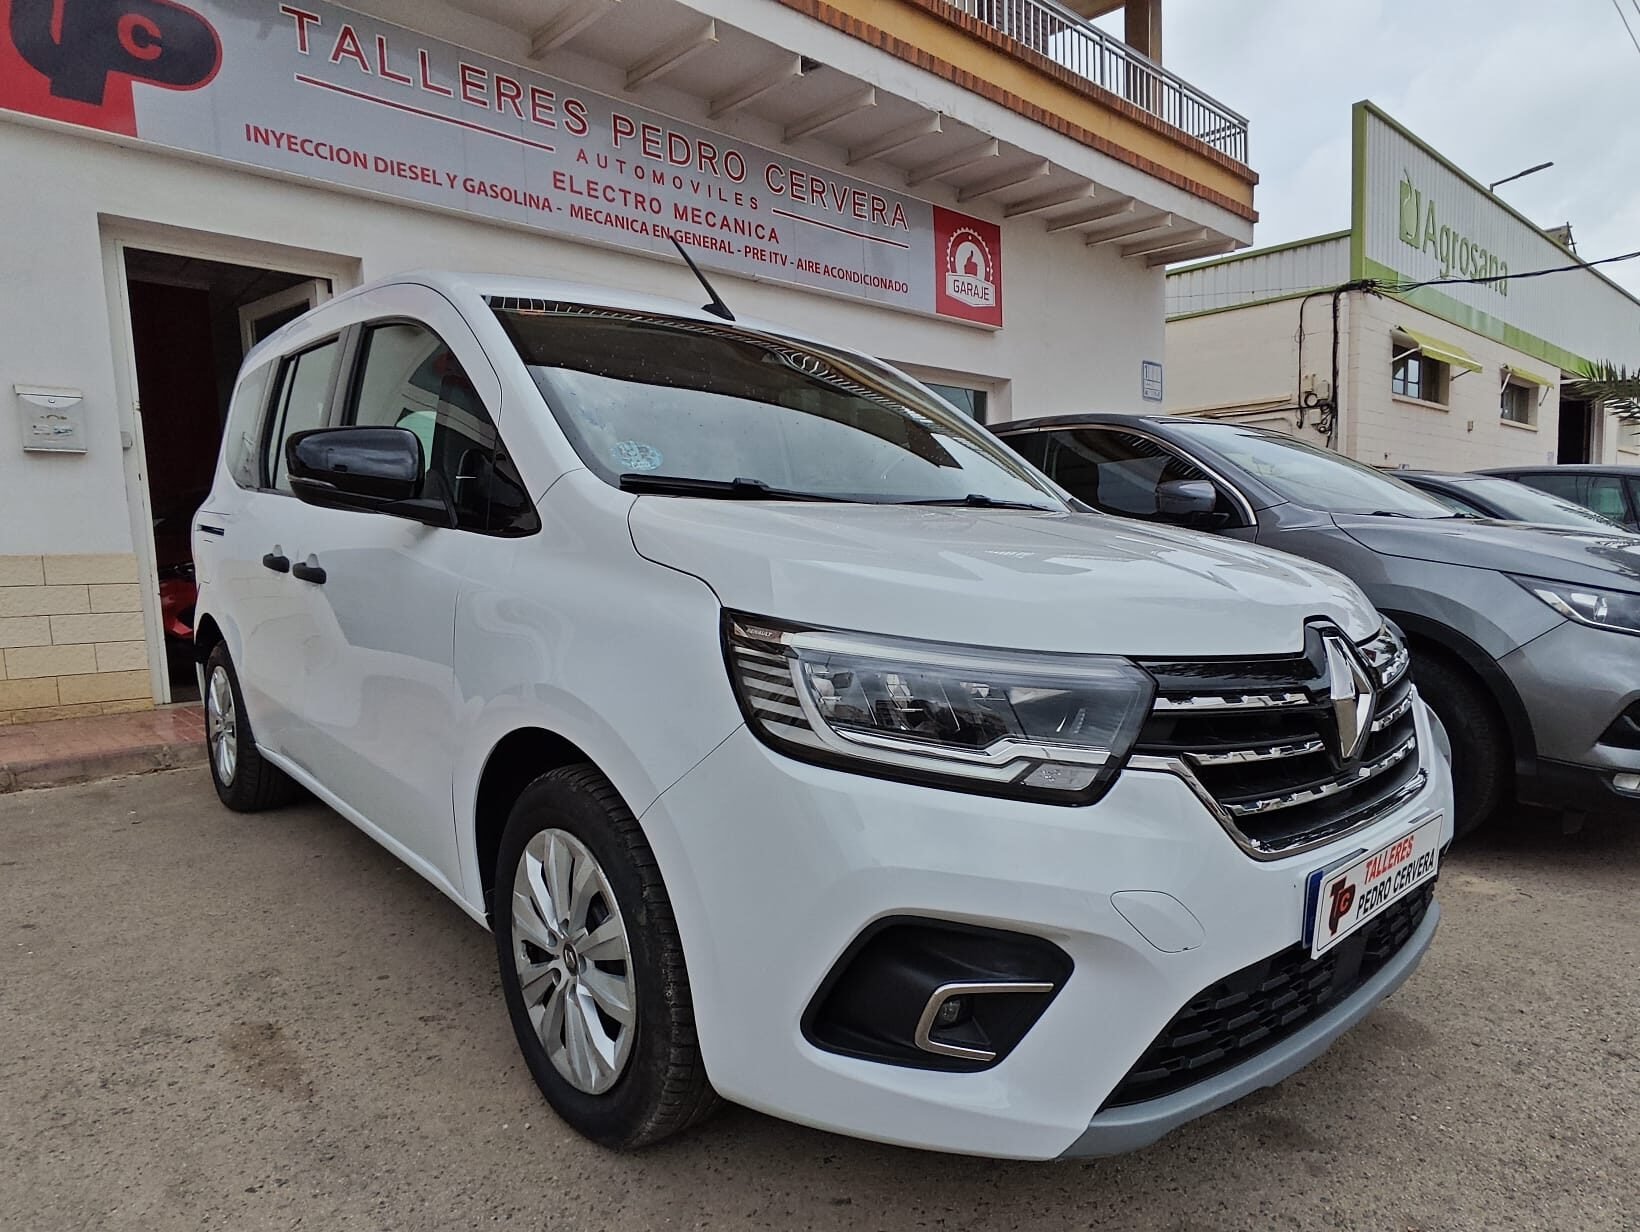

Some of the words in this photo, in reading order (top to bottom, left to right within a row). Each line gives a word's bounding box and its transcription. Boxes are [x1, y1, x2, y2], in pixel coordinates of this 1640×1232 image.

[279, 3, 589, 137] TALLERES
[611, 112, 747, 183] PEDRO
[764, 162, 910, 233] CERVERA
[245, 123, 369, 170] INYECCION
[373, 156, 443, 186] DIESEL
[446, 172, 458, 189] Y
[462, 177, 553, 212] GASOLINA
[570, 203, 650, 235] MECANICA
[652, 223, 671, 240] EN
[673, 229, 735, 254] GENERAL
[744, 245, 767, 262] PRE
[769, 250, 788, 267] ITV
[796, 257, 821, 275] AIRE
[823, 264, 909, 294] ACONDICIONADO
[552, 170, 662, 214] ELECTRO
[673, 202, 780, 244] MECANICA
[576, 148, 758, 210] AUTOMOVILES
[1422, 199, 1508, 297] Agrosana
[953, 279, 990, 301] GARAJE
[1356, 876, 1392, 920] PEDRO
[1393, 848, 1436, 893] CERVERA
[1364, 835, 1414, 885] TALLERES
